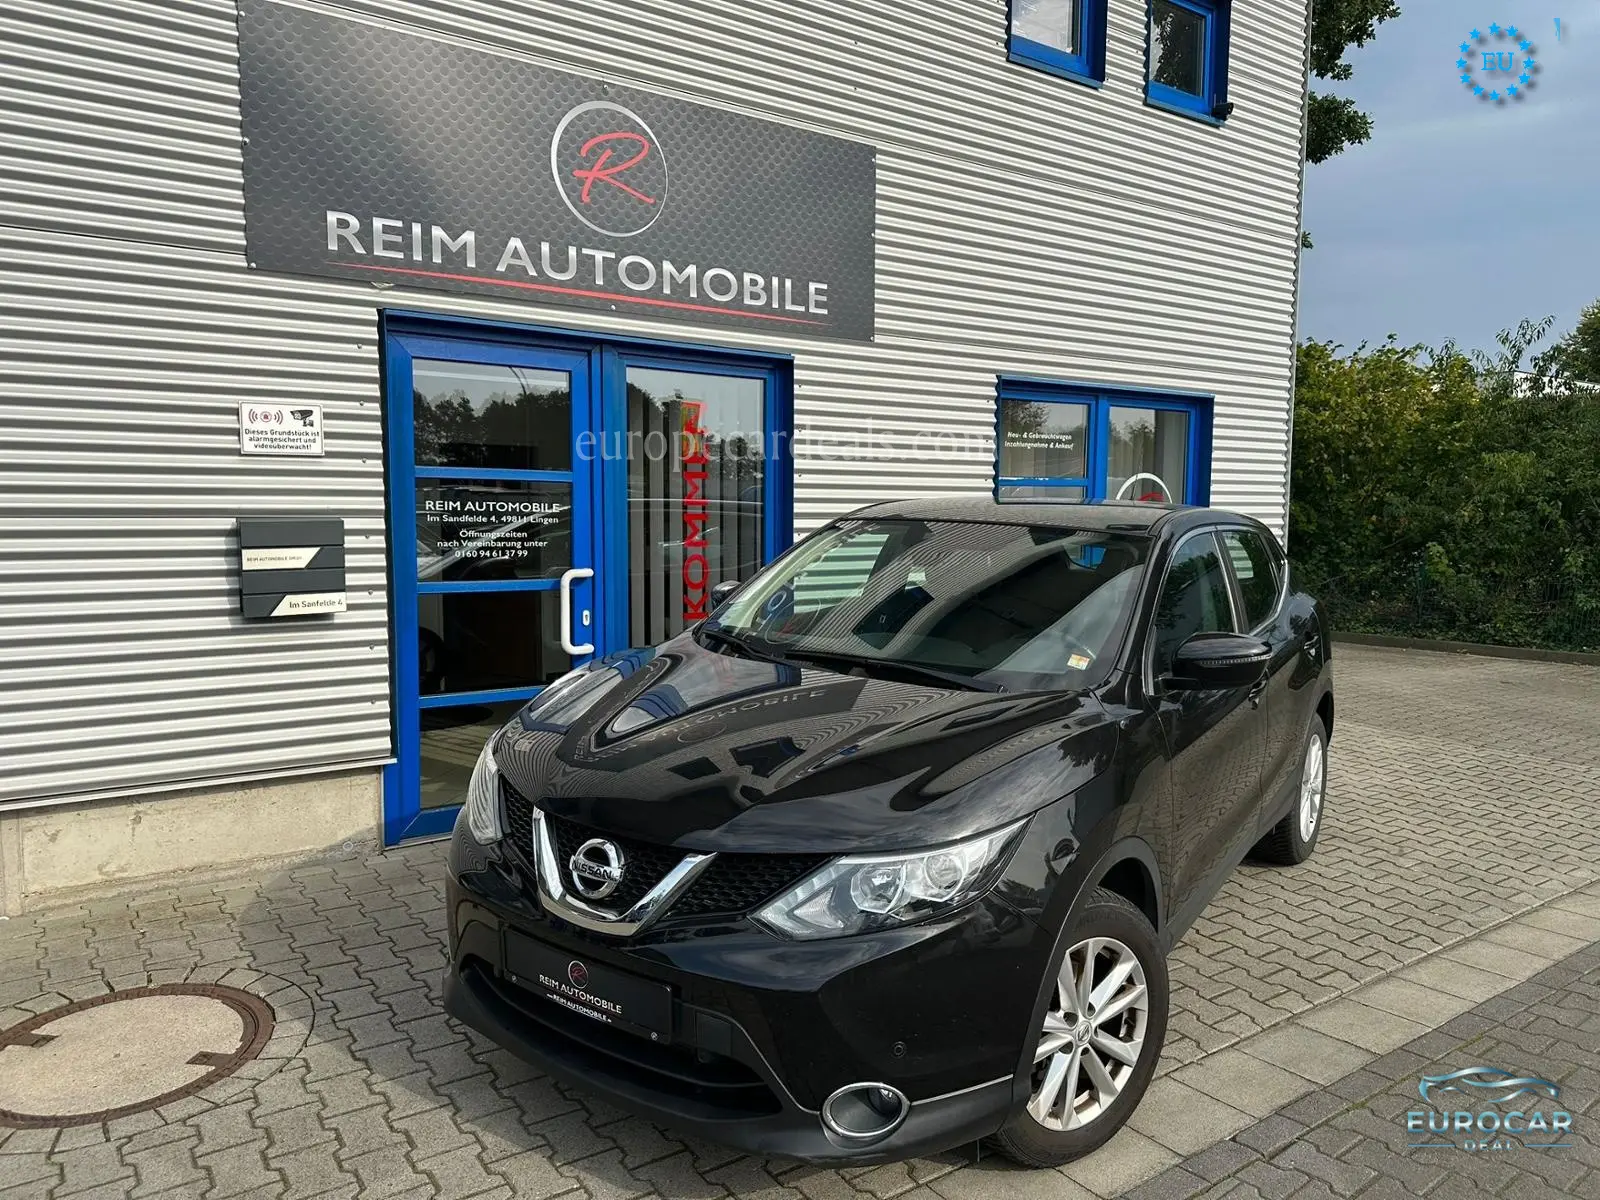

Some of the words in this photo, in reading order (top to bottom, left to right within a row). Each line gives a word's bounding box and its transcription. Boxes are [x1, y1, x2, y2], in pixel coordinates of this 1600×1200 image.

[573, 132, 655, 203] R
[326, 210, 477, 268] REIM
[496, 237, 829, 316] AUTOMOBILE
[244, 428, 268, 436] Dieses
[425, 500, 461, 511] REIM
[464, 501, 560, 513] AUTOMOBILE
[427, 514, 440, 522] Im
[442, 514, 488, 523] Sandfelde
[490, 515, 499, 524] 4,
[530, 516, 559, 525] Lingen
[459, 528, 528, 539] Öffnungszeiten
[461, 540, 521, 549] Vereinbarung
[455, 550, 478, 558] 0160
[479, 550, 491, 558] 94
[516, 550, 529, 558] 99
[289, 601, 300, 609] Im
[571, 860, 612, 880] NISSAN
[539, 974, 559, 990] REIM
[560, 983, 622, 1014] AUTOMOBILE
